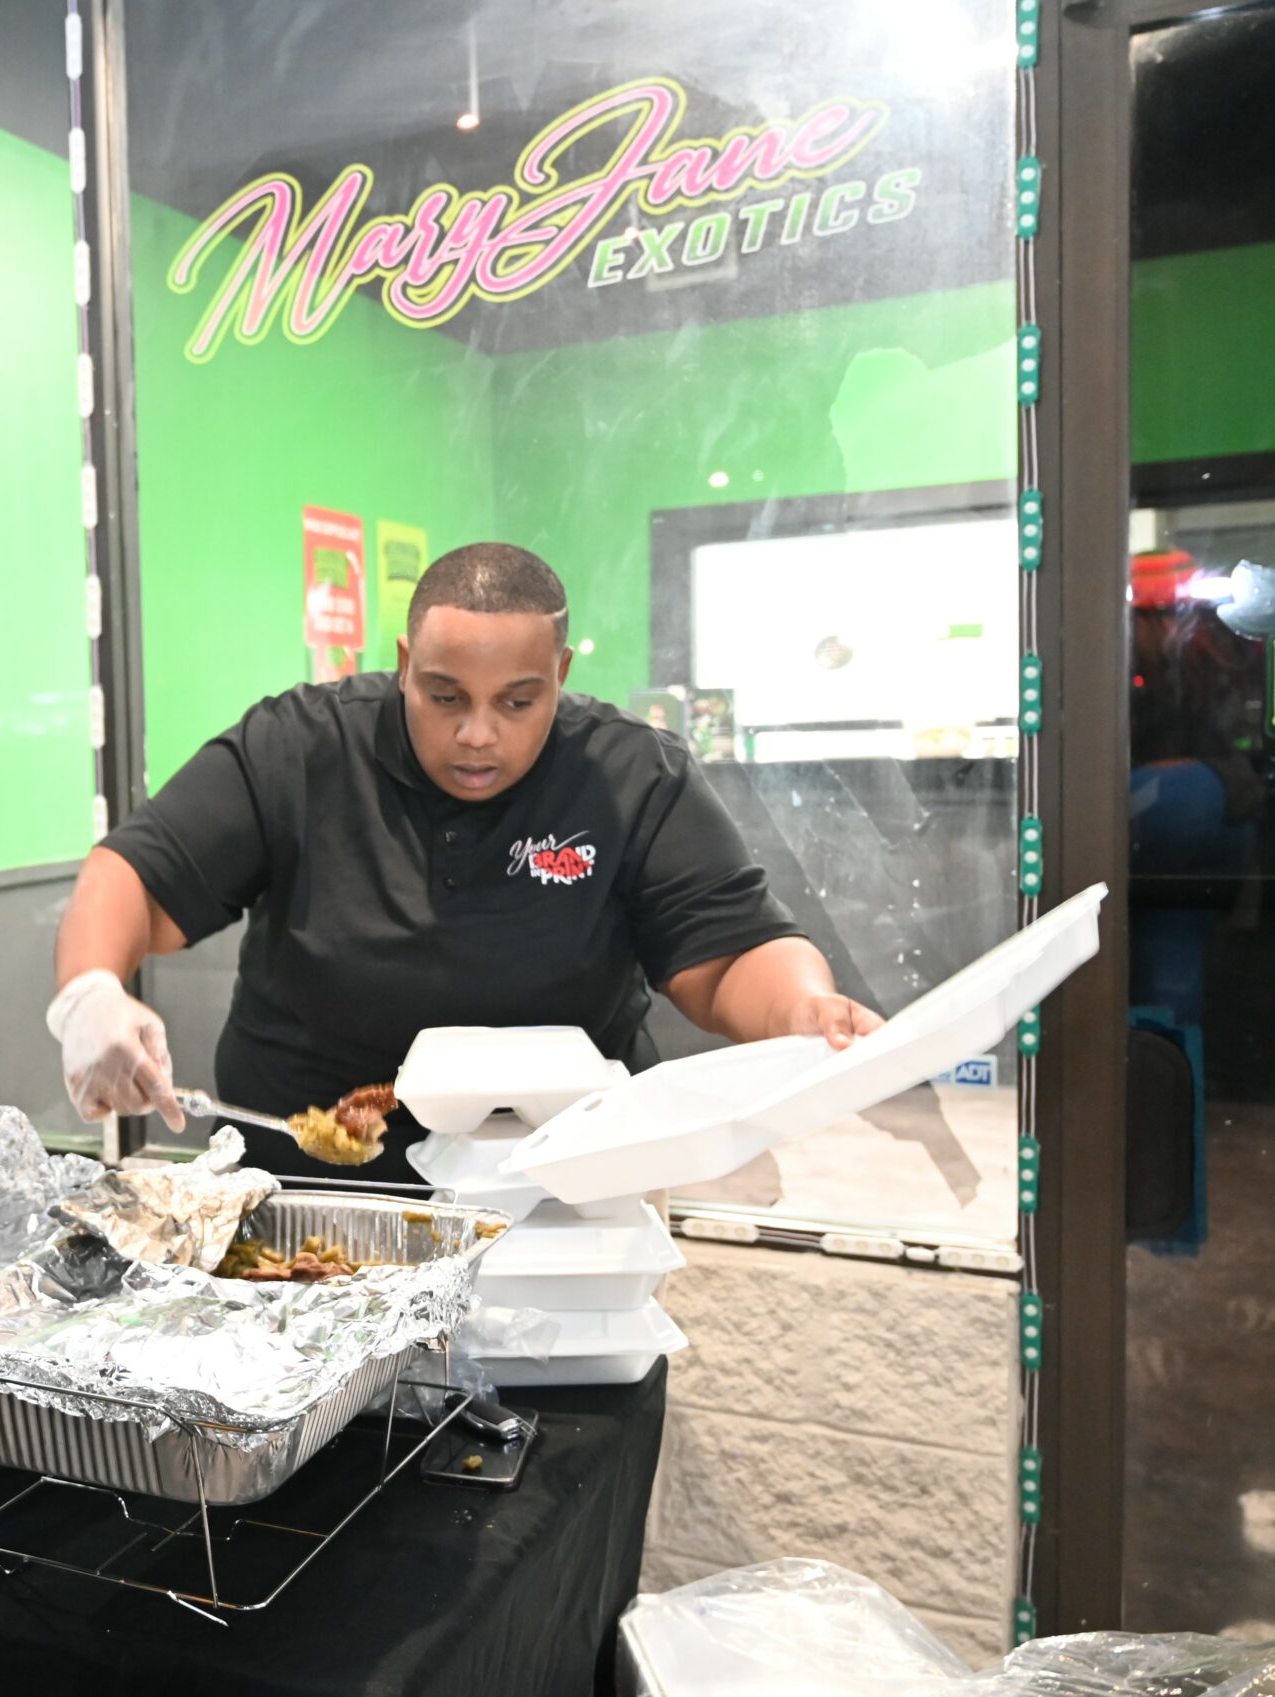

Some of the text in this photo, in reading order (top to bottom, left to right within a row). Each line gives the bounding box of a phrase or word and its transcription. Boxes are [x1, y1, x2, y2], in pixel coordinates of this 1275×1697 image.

[587, 168, 923, 288] EXOTICS
[507, 832, 582, 876] Your
[956, 1063, 991, 1082] ADT
